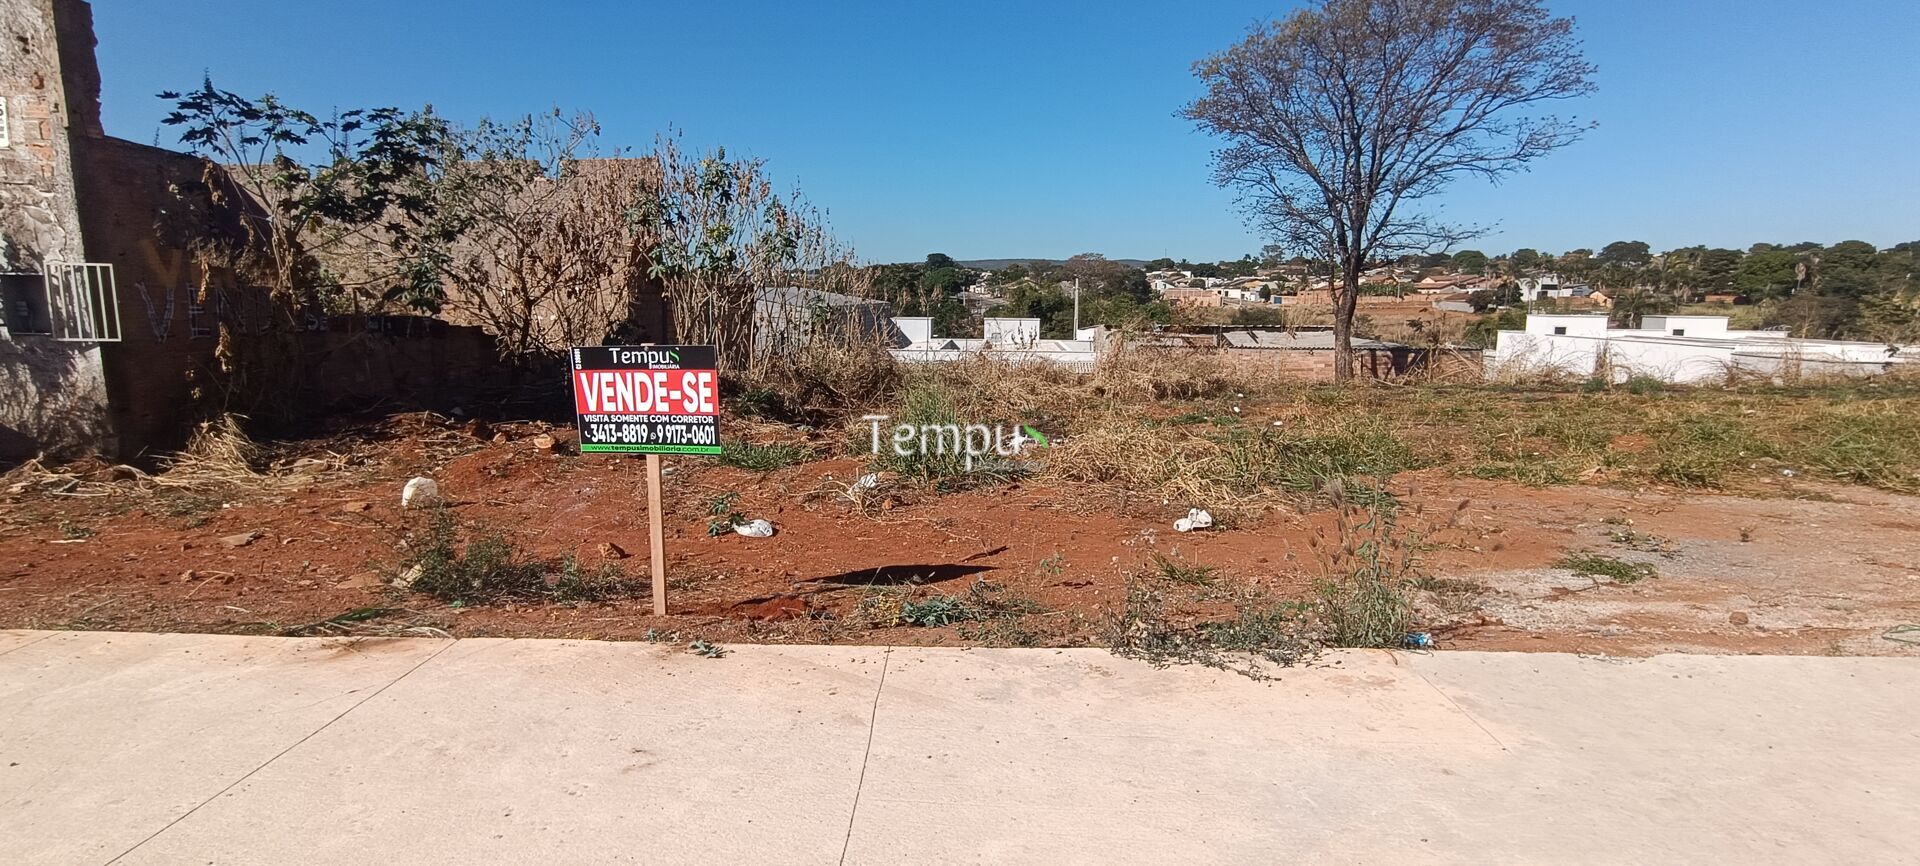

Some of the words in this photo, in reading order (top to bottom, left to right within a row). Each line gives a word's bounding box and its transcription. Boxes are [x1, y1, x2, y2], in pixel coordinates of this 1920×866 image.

[579, 372, 714, 413] VENDE-SE
[583, 414, 610, 423] VISITA
[610, 414, 649, 423] SOMENTE
[649, 415, 670, 423] COM
[670, 415, 714, 424] CORRETOR
[590, 424, 648, 443] 3413-8819
[656, 425, 664, 443] 9
[665, 425, 716, 445] 9173-0601
[590, 444, 710, 453] www.tempusimobiliaria.com.br
